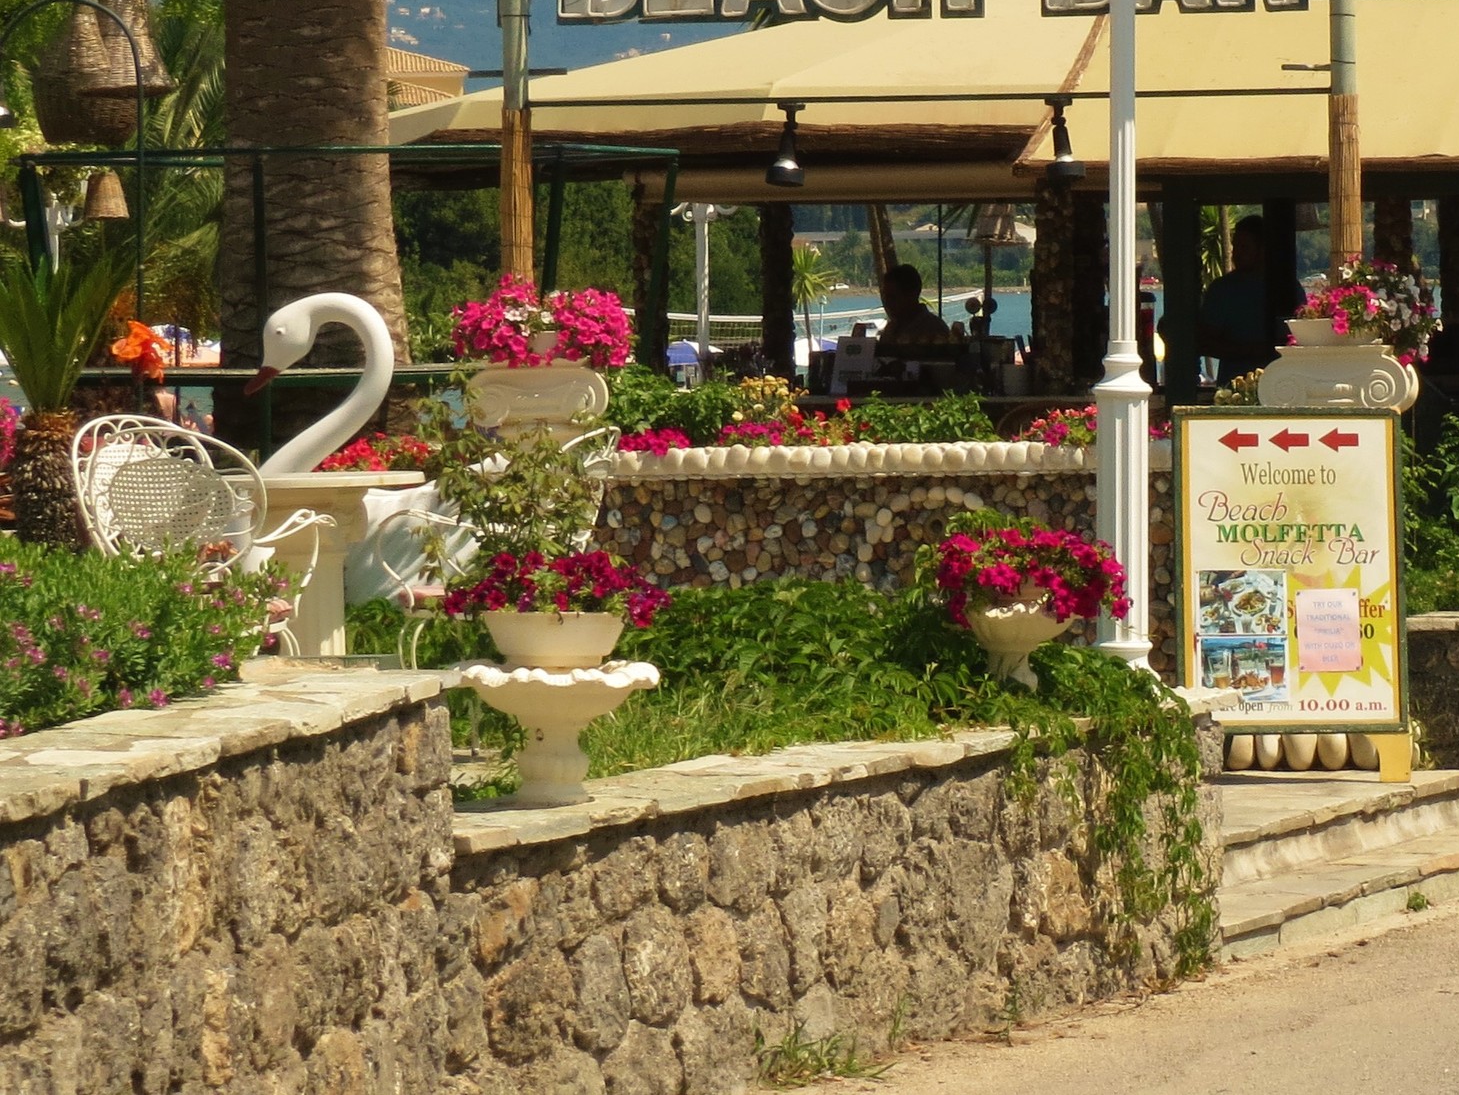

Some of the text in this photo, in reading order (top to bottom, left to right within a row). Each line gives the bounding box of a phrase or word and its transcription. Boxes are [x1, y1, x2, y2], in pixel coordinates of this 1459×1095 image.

[1241, 462, 1336, 485] Welcome to
[1198, 490, 1288, 522] Beach
[1216, 523, 1365, 543] MOLFETTA
[1240, 537, 1381, 566] Snack Bar
[1359, 598, 1386, 618] ffer
[1239, 701, 1263, 714] open
[1267, 701, 1293, 713] from
[1299, 699, 1350, 711] 10.00
[1355, 700, 1387, 711] a.m.
